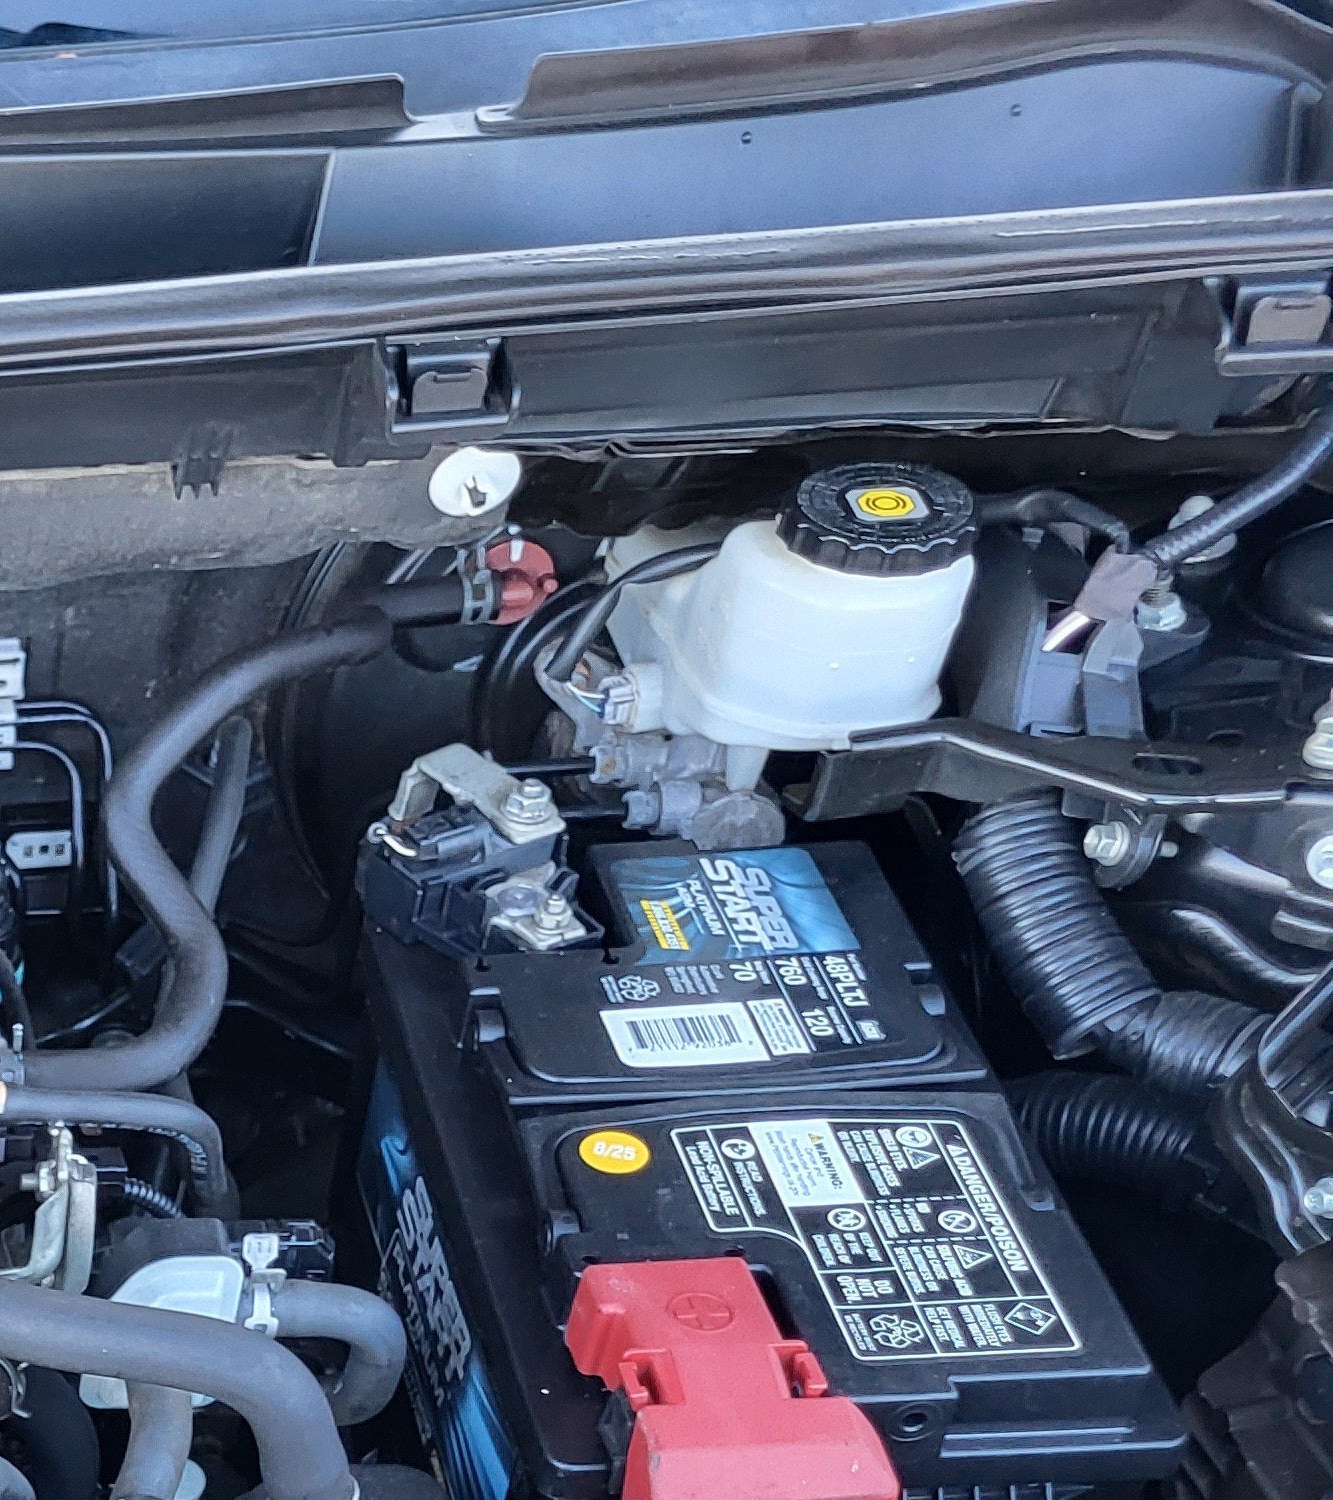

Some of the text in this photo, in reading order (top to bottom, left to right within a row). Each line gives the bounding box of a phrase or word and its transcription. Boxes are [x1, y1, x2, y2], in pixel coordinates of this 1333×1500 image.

[685, 879, 726, 935] PLATINUM
[697, 857, 775, 951] START
[734, 867, 800, 948] SUPER
[726, 961, 758, 981] 70
[771, 957, 809, 985] 760
[819, 955, 870, 1007] 48PLTJ
[798, 1008, 836, 1036] 120
[694, 1141, 739, 1215] NON-SPILLABLE
[812, 1142, 845, 1188] WARNING:
[951, 1157, 1029, 1271] DANGER/POISON
[854, 1278, 878, 1297] NOT
[872, 1279, 895, 1294] DO
